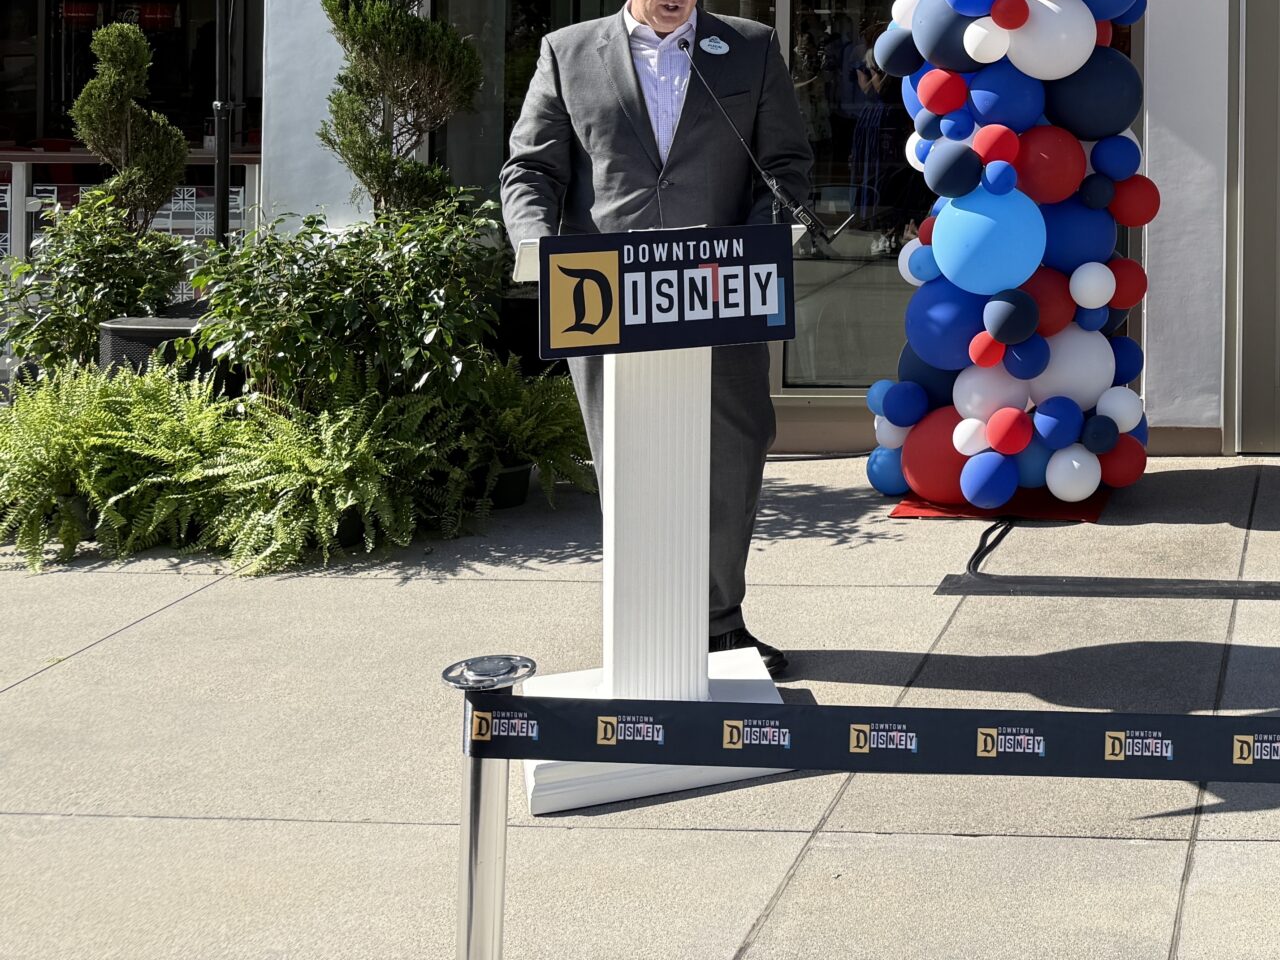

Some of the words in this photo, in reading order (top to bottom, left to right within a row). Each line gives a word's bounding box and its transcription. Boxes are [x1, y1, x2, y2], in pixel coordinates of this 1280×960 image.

[623, 239, 744, 265] DOWNTOWN
[556, 264, 772, 335] DISNEY
[474, 714, 536, 736] DISNEY
[618, 714, 653, 722] DOWNTOWN
[744, 718, 780, 726] DOWNTOWN
[600, 719, 662, 741] DISNEY
[726, 723, 788, 745] DISNEY
[852, 727, 915, 749] DISNEY
[980, 731, 1043, 753] DISNEY
[1107, 735, 1171, 757] DISNEY
